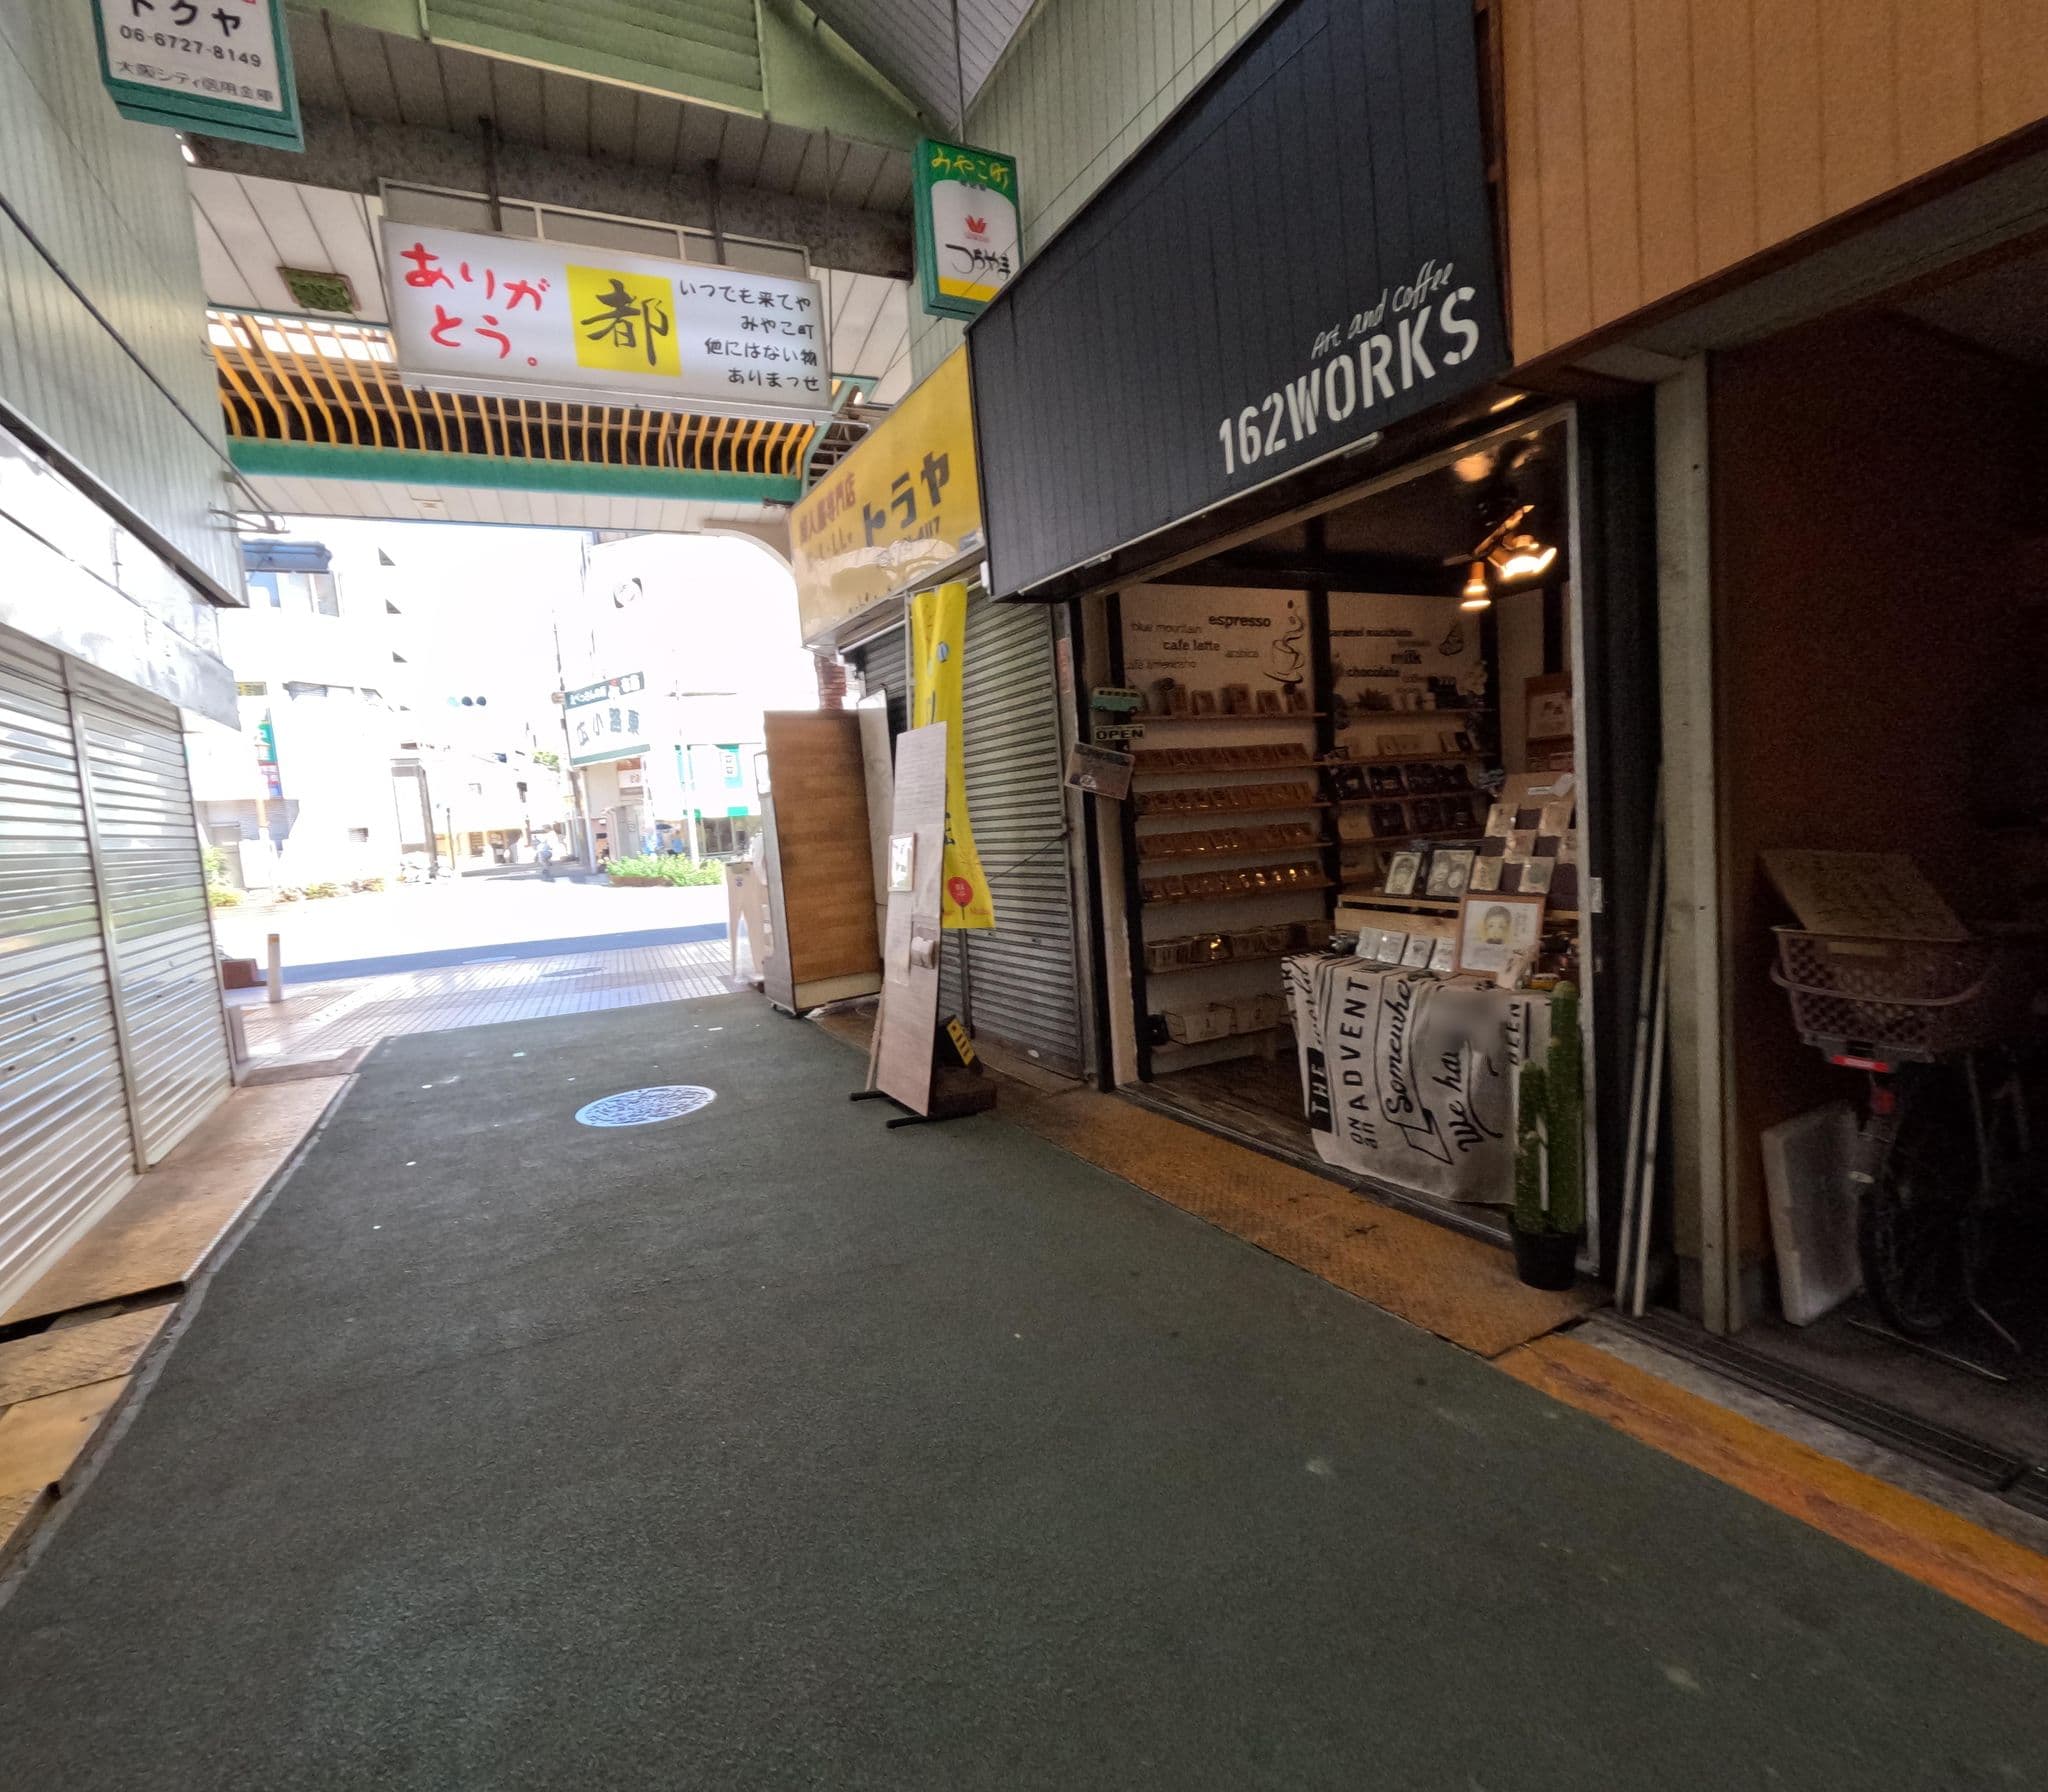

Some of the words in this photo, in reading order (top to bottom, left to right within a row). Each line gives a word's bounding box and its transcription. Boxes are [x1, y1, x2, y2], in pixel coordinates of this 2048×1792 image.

[120, 25, 262, 68] 06-6727-8149
[931, 148, 1009, 189] みやこ町
[400, 242, 551, 311] ありが
[679, 280, 812, 312] いつでも来てや
[580, 278, 669, 366] 都
[740, 315, 815, 342] みやこ町
[1347, 288, 1389, 339] and
[705, 338, 819, 368] 他にはない物
[728, 368, 821, 393] ありまっせ
[1219, 286, 1479, 475] 162WORKS
[863, 451, 950, 547] トラヤ
[1208, 614, 1271, 629] espresso
[1096, 729, 1144, 740] OPEN
[1448, 1100, 1485, 1153] We
